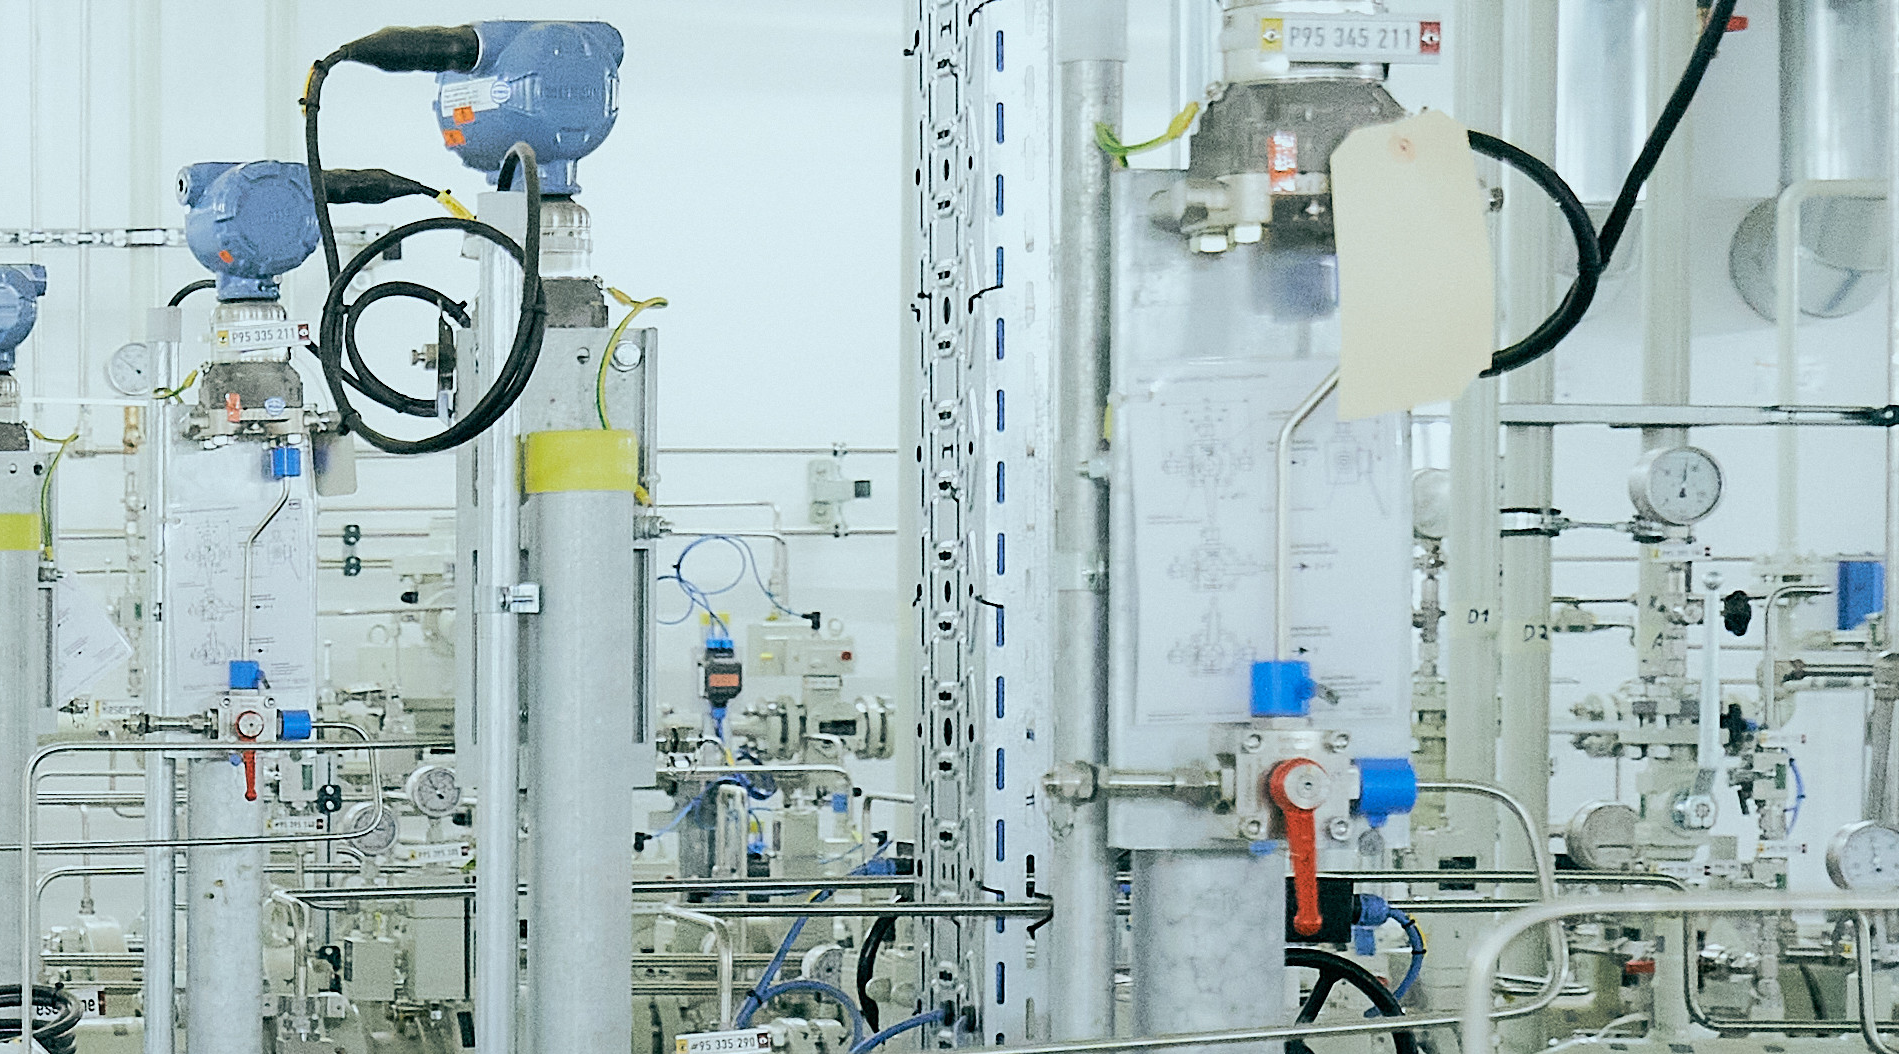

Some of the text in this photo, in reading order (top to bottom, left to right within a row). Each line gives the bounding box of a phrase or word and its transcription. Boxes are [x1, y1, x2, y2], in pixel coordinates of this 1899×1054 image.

[1289, 26, 1412, 49] P95 345 211
[232, 327, 295, 343] P95 335 211
[1467, 608, 1490, 624] D1
[1523, 624, 1549, 642] D2
[716, 1039, 733, 1050] 335
[738, 1037, 755, 1047] 290
